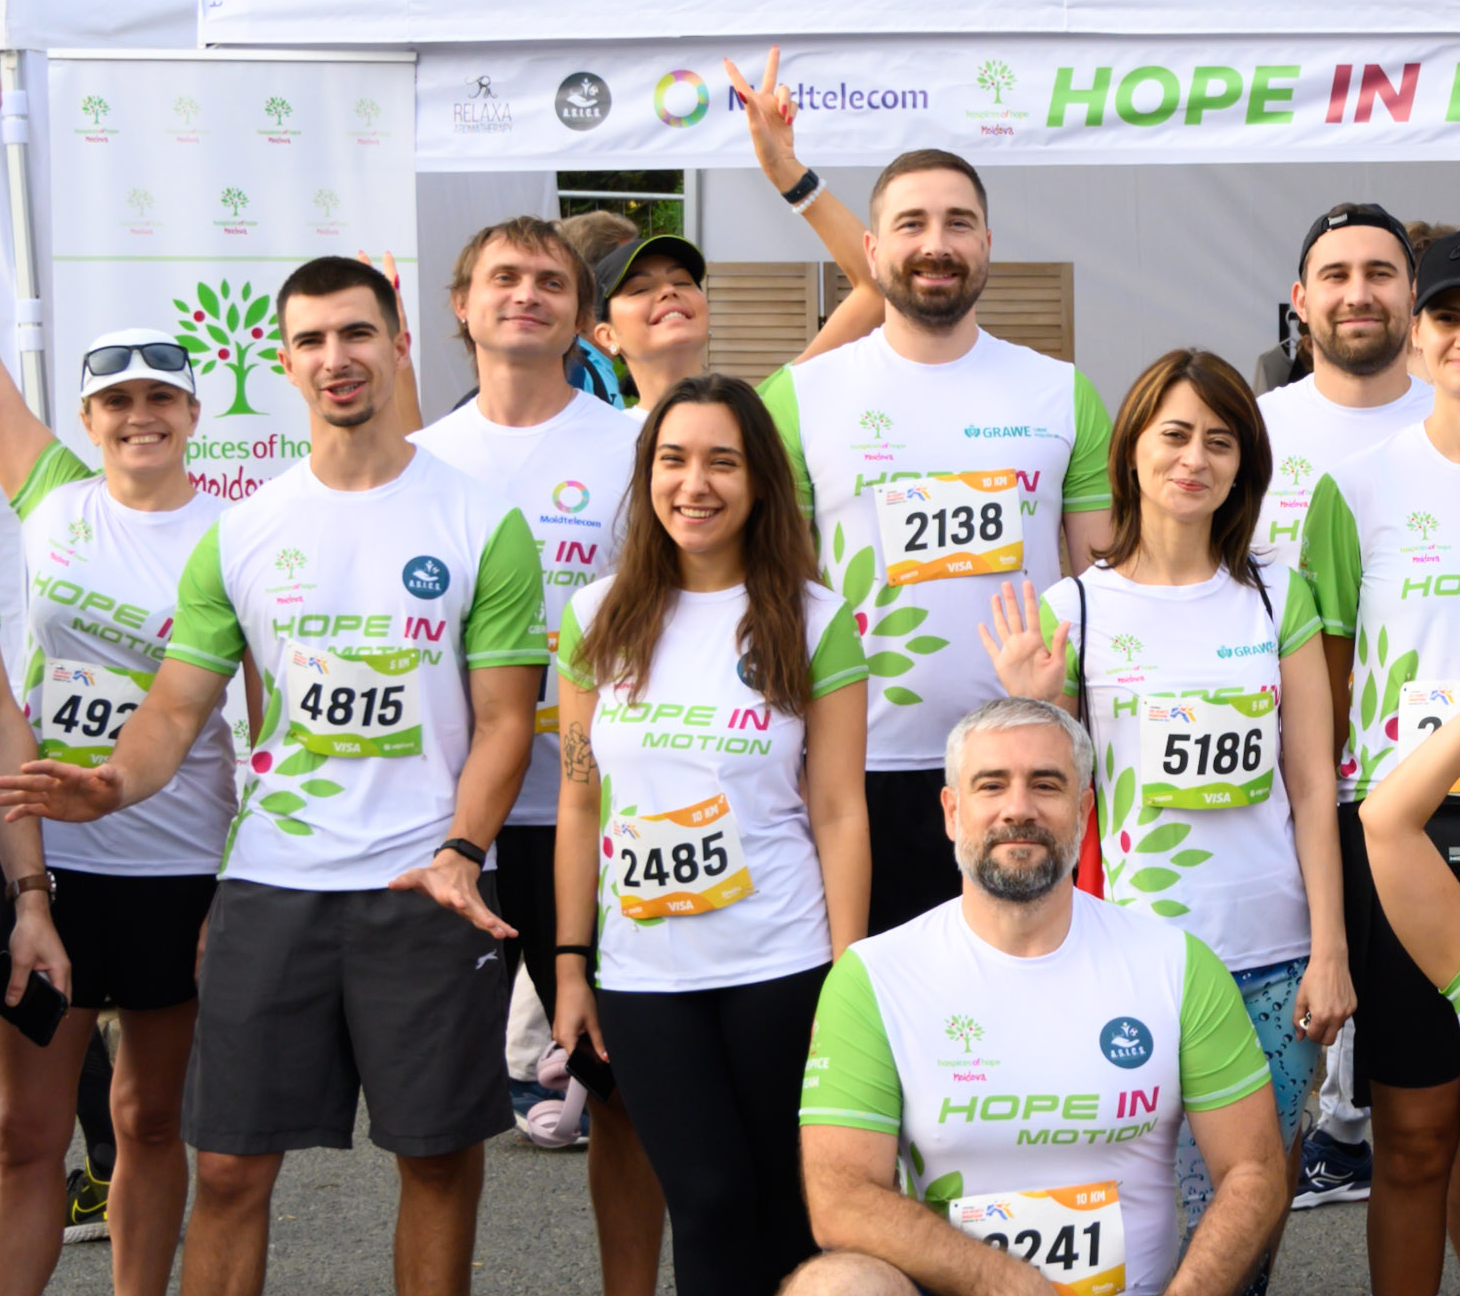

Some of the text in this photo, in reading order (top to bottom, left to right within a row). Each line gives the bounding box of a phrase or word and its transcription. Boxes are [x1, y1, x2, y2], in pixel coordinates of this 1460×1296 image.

[1046, 65, 1301, 128] HOPE
[1325, 63, 1421, 123] IN
[454, 103, 512, 122] RELAXA
[983, 425, 1032, 439] GRAWE
[540, 515, 602, 529] Moldtelecom
[904, 502, 1004, 553] 2138
[555, 540, 597, 565] IN
[946, 560, 973, 573] VISA
[31, 570, 149, 630] HOPE
[72, 616, 167, 664] MOTIO
[272, 614, 446, 643] HOPE IN
[300, 682, 406, 727] 4815
[597, 701, 771, 731] HOPE IN
[332, 741, 362, 753] VISA
[642, 732, 773, 755] MOTION
[1162, 727, 1263, 777] 5186
[1203, 791, 1232, 804] VISA
[621, 830, 729, 888] 2485
[666, 899, 695, 912] VISA
[938, 1085, 1161, 1124] HOPE IN
[1017, 1117, 1160, 1146] MOTION
[1076, 1190, 1106, 1206] 10 KM
